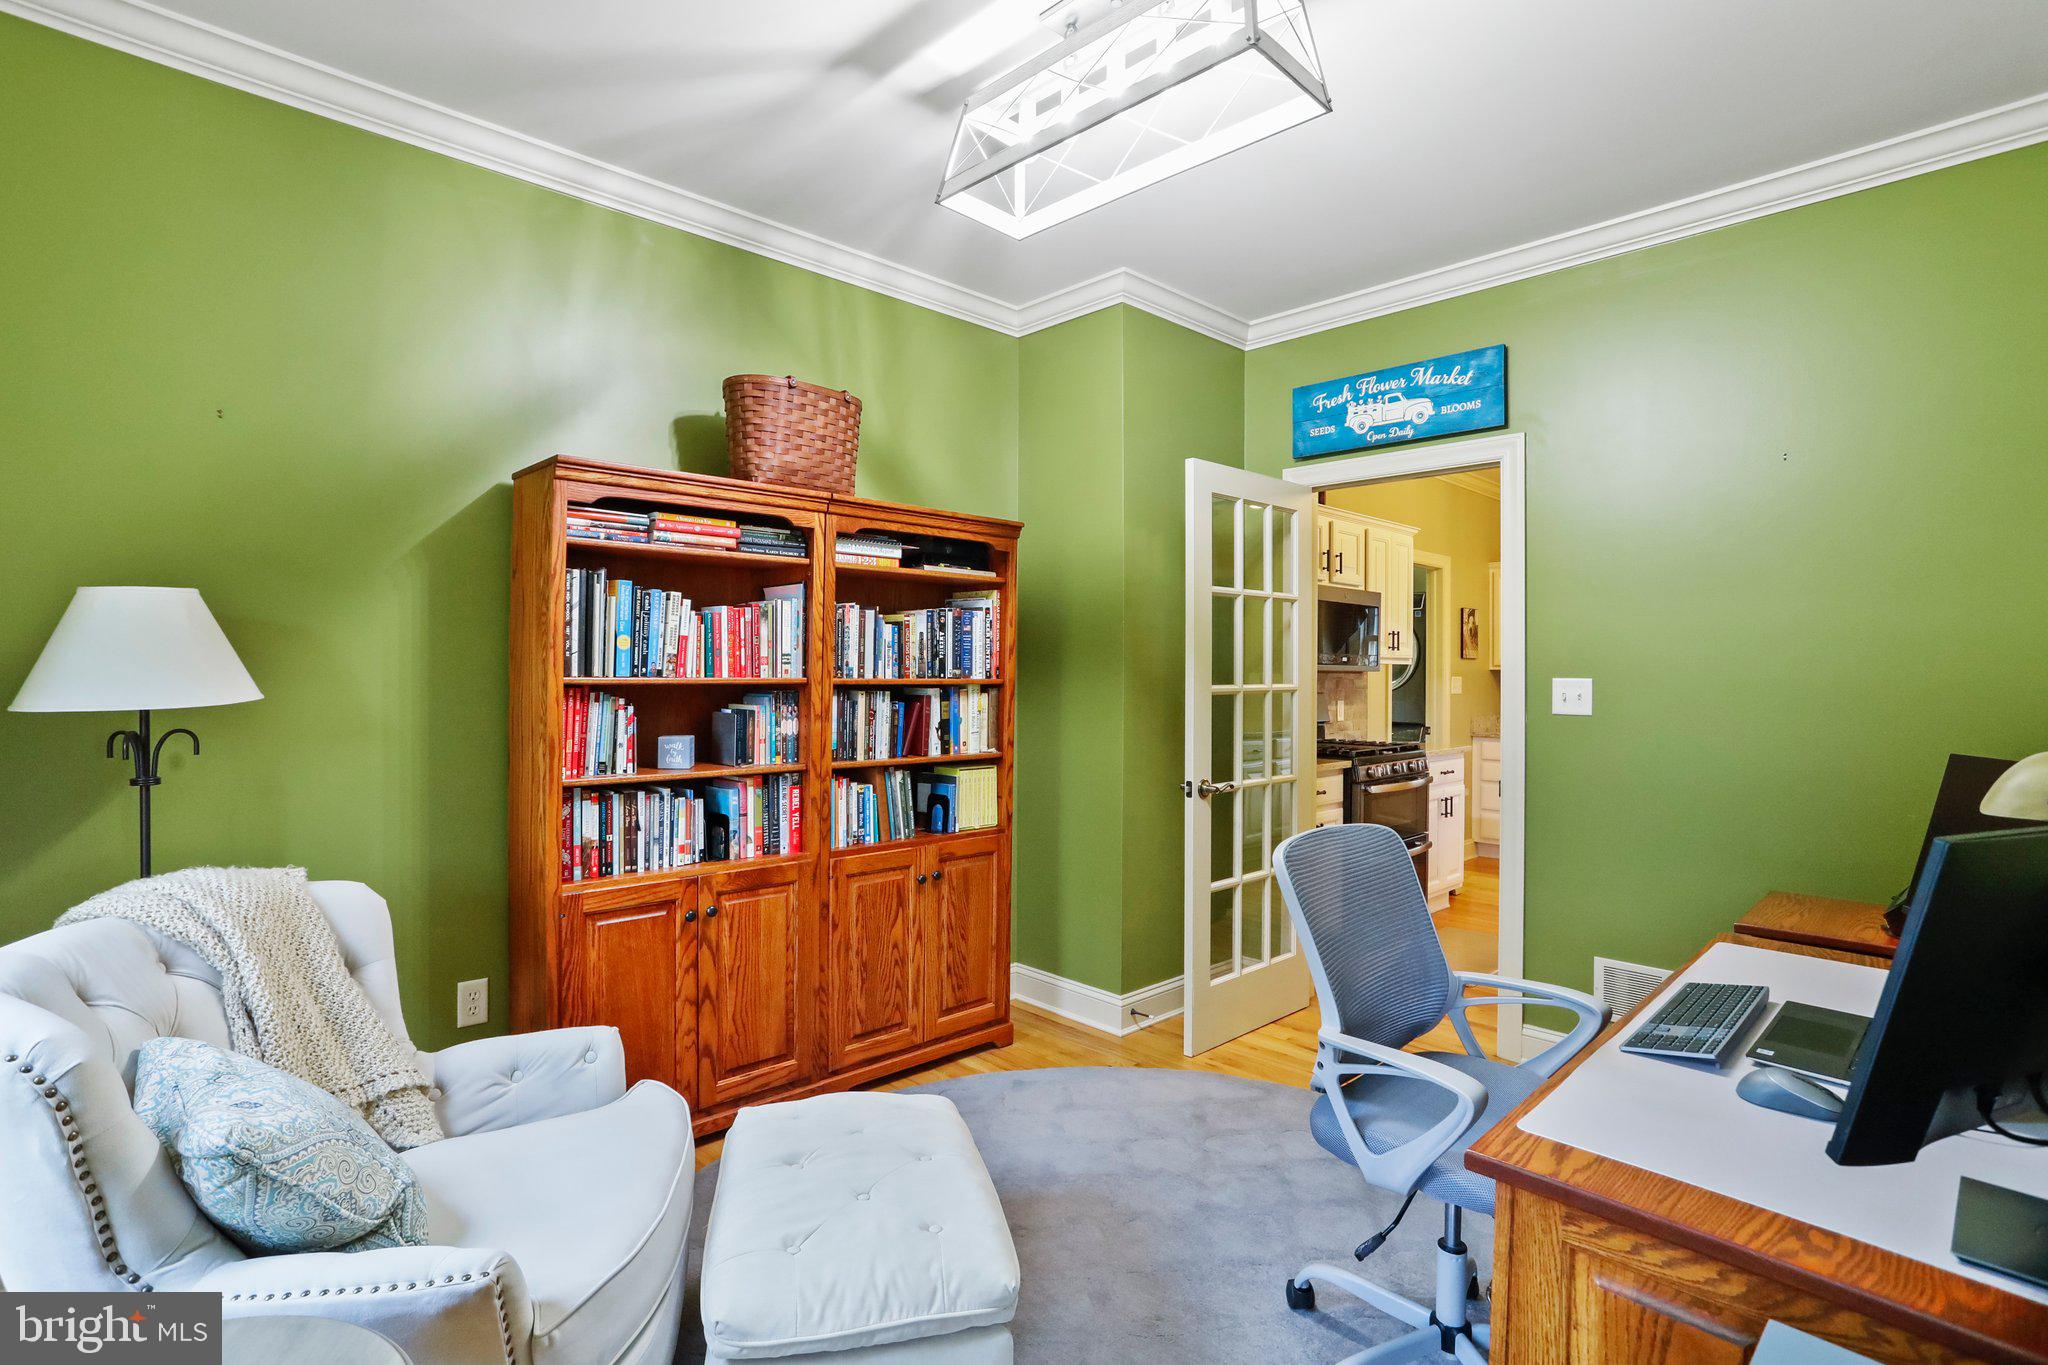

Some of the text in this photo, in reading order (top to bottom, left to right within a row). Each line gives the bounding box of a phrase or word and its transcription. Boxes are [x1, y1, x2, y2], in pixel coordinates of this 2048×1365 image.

[1312, 365, 1474, 414] Fresh Flower Market
[1440, 399, 1482, 415] BLOOMS
[1309, 425, 1336, 437] SEEDS
[1366, 424, 1415, 443] Open Daily
[643, 595, 651, 611] cash
[641, 614, 650, 655] johnny cash
[663, 741, 685, 751] walk
[665, 754, 683, 764] faith
[791, 789, 800, 811] REBEL
[792, 812, 800, 830] YELL
